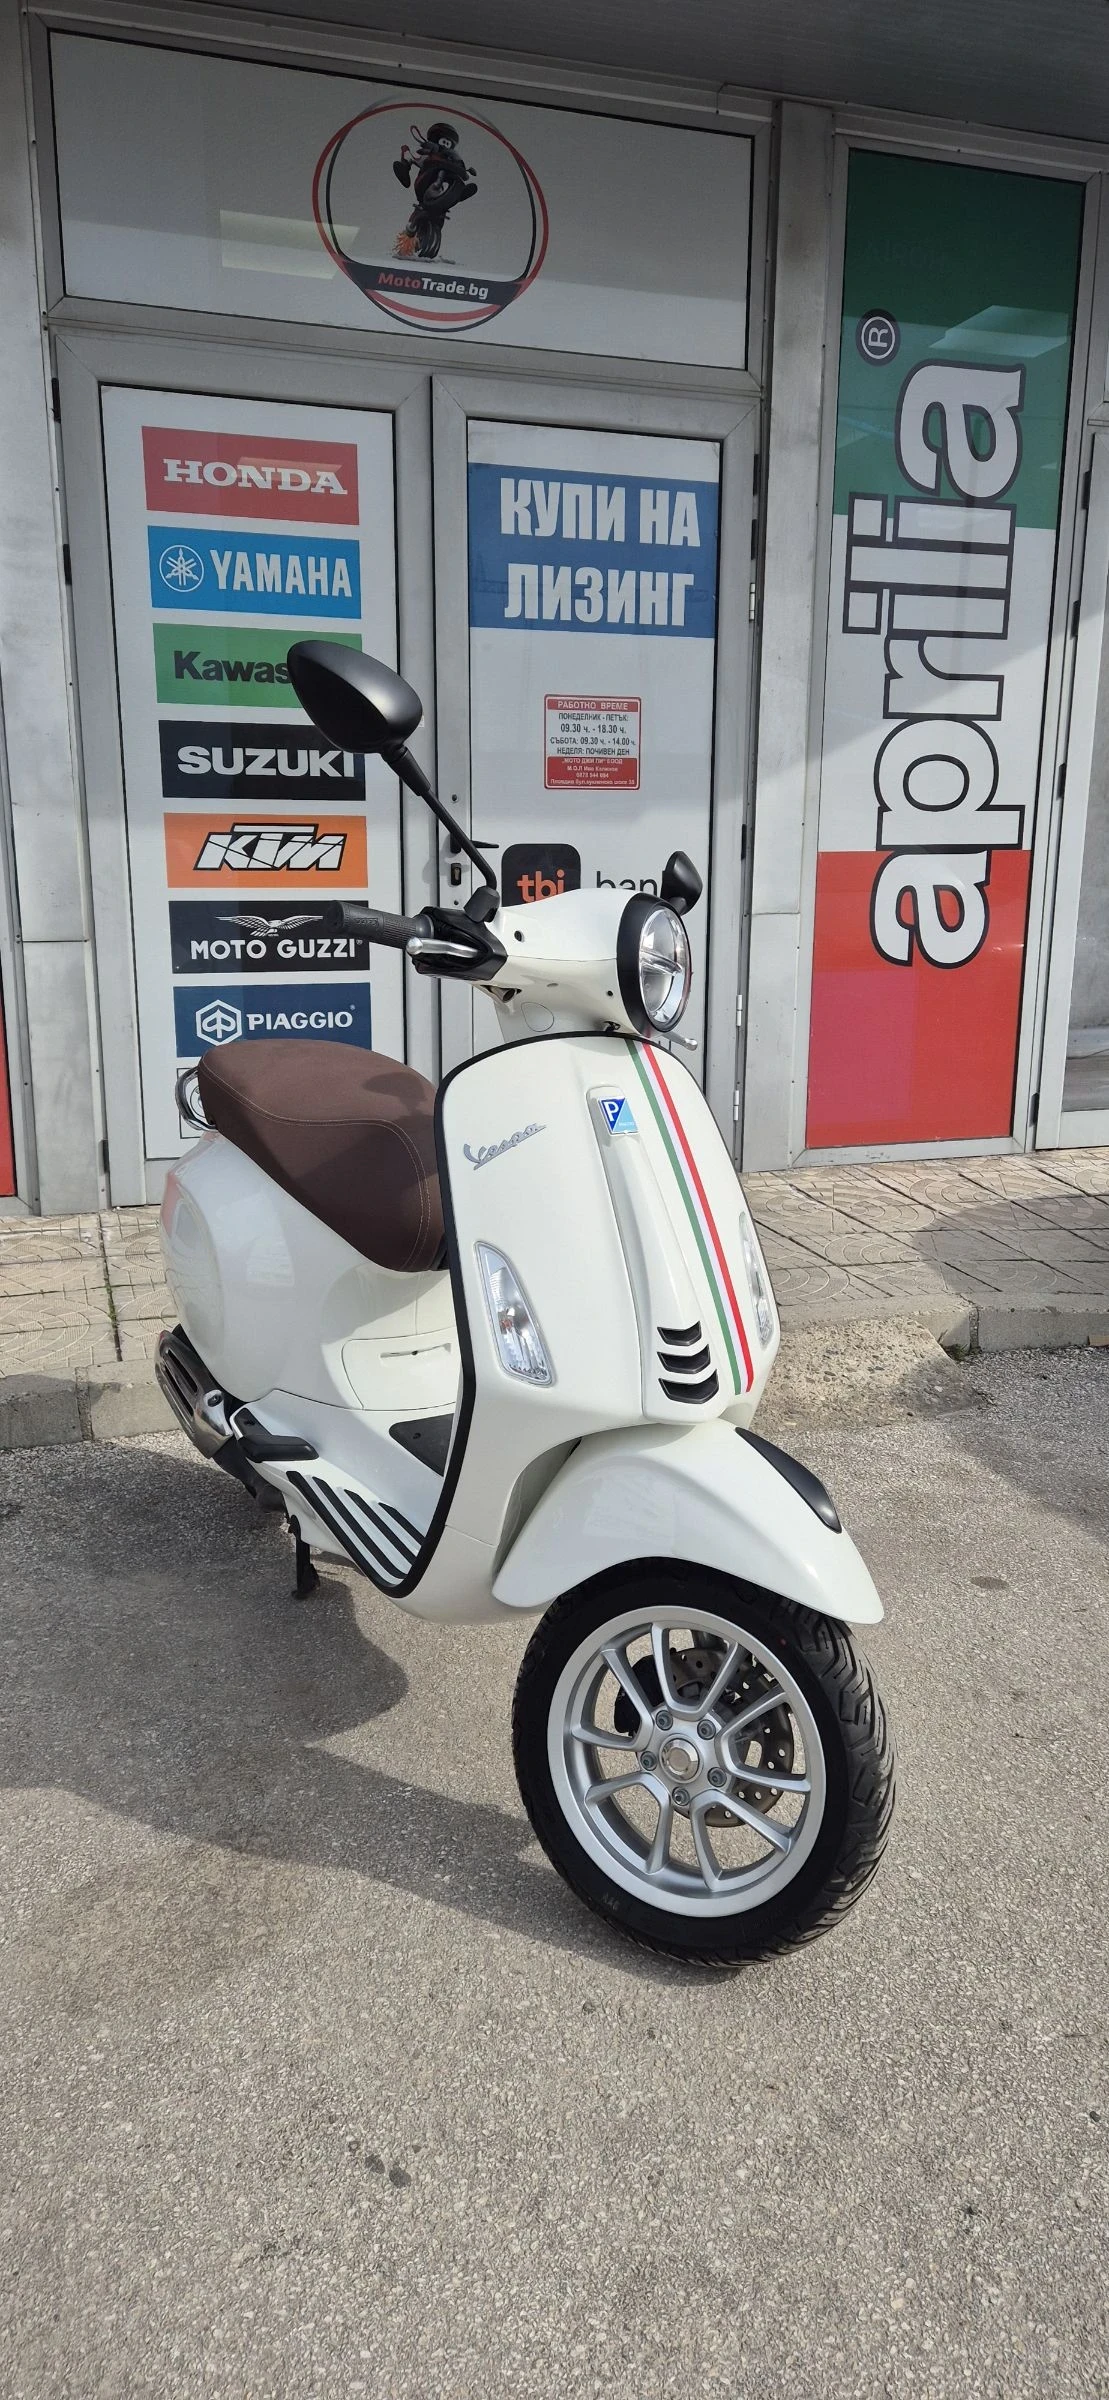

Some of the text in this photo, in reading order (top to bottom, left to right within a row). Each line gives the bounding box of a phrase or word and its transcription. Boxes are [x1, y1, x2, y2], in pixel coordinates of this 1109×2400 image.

[378, 272, 489, 300] MotoTrade.bg
[163, 458, 348, 495] HONDA
[500, 477, 701, 547] КУПИ НА
[210, 549, 353, 598] YAMAHA
[504, 562, 695, 627] ЛИЗИНГ
[173, 650, 294, 684] Kawas
[843, 360, 1026, 970] aprilia
[557, 700, 629, 711] РАБОТНО ВРЕМЕ
[558, 712, 601, 721] ПОНЕДЕЛНИК
[549, 736, 579, 745] СЪБОТА:
[580, 736, 599, 745] 09.30
[612, 737, 630, 746] 14.00
[560, 723, 581, 733] 09.30
[597, 724, 618, 734] 18.30
[177, 745, 356, 778] SUZUKI
[585, 747, 616, 756] ПОЧИВЕН
[616, 748, 630, 756] ДЕН
[193, 822, 348, 871] KTM
[517, 869, 658, 903] tbi ban
[190, 939, 267, 960] MOTO
[247, 1010, 354, 1031] PIAGGIO
[463, 1122, 547, 1171] Vespa
